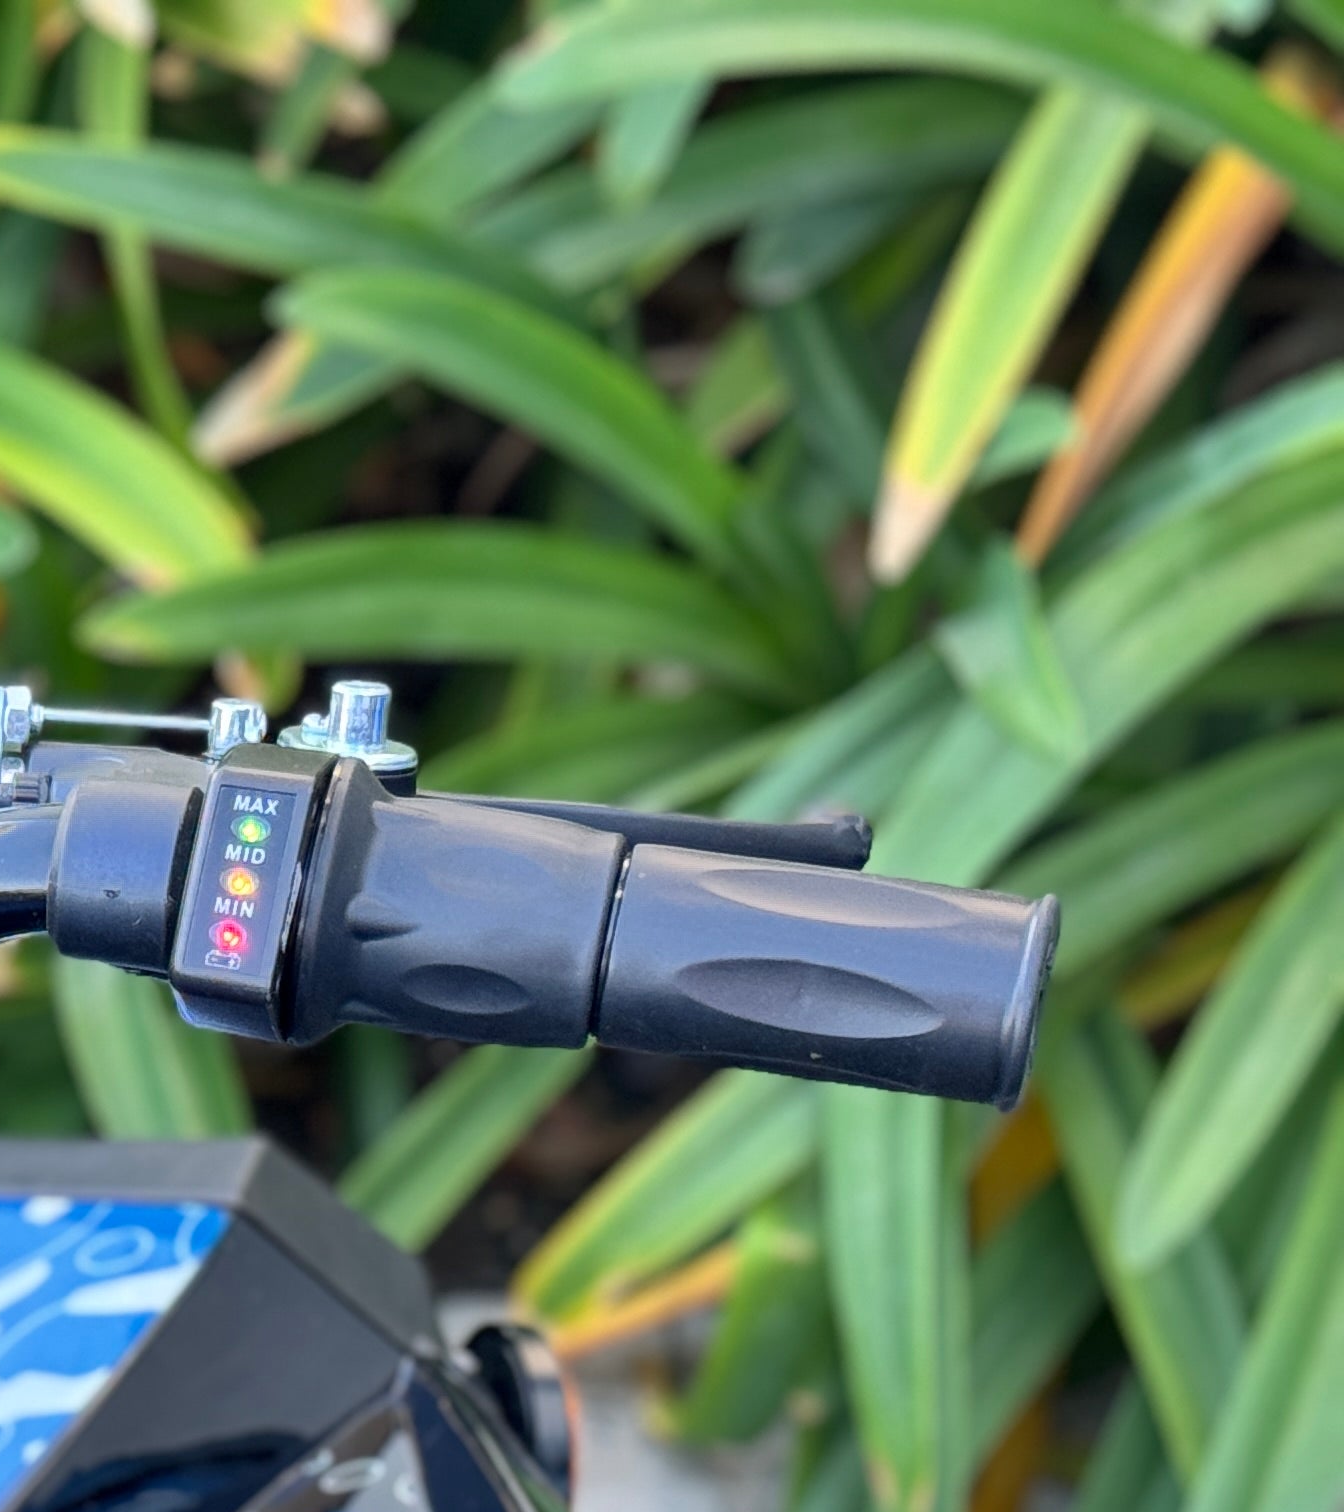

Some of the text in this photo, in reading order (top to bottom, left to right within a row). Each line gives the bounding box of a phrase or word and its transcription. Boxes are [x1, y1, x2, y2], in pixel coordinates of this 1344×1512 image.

[233, 794, 280, 816] MAX
[224, 844, 266, 865] MID
[214, 897, 255, 919] MIN
